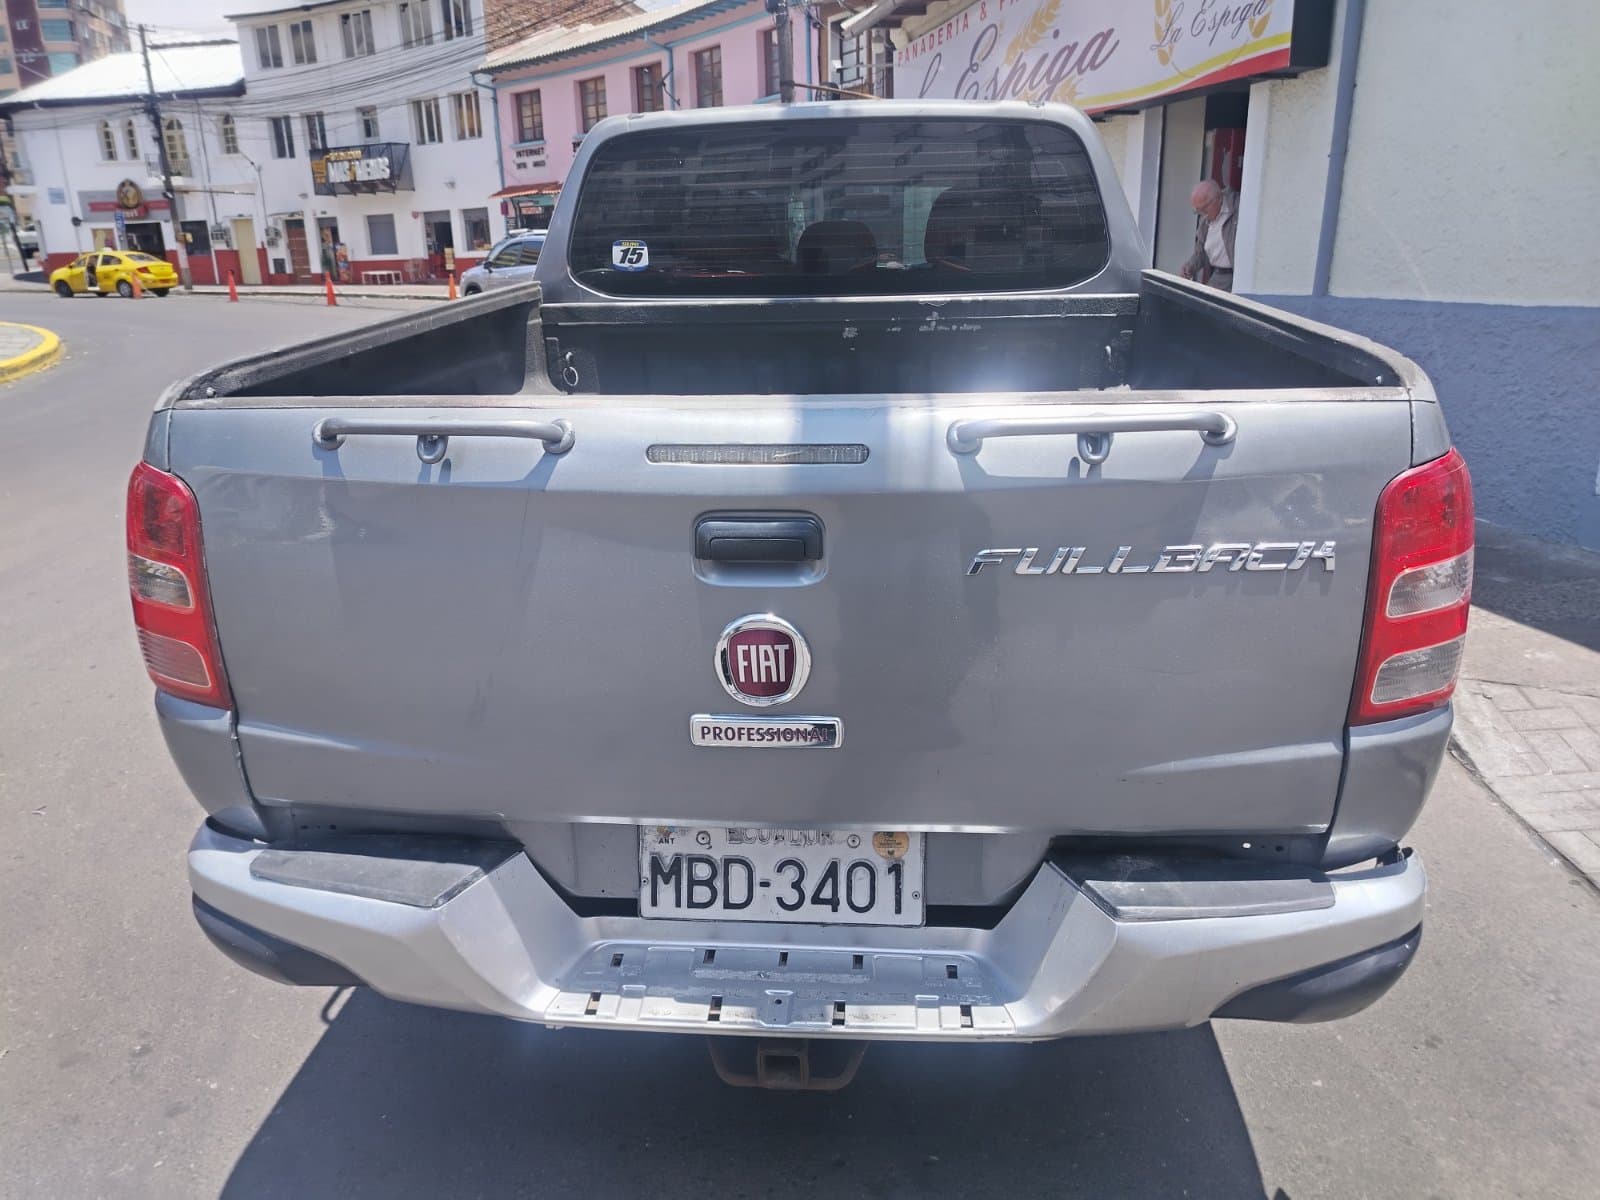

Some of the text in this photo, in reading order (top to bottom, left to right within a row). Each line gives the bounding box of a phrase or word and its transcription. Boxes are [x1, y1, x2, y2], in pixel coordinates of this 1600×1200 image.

[1190, 0, 1268, 48] Espiga
[953, 23, 1120, 101] Espiga
[619, 247, 646, 265] 15
[965, 541, 1337, 576] FULLBACK
[736, 644, 790, 683] FIAT
[701, 725, 829, 743] PROFESSIONAL
[657, 836, 675, 845] ANT
[649, 853, 903, 915] MBD-3401
